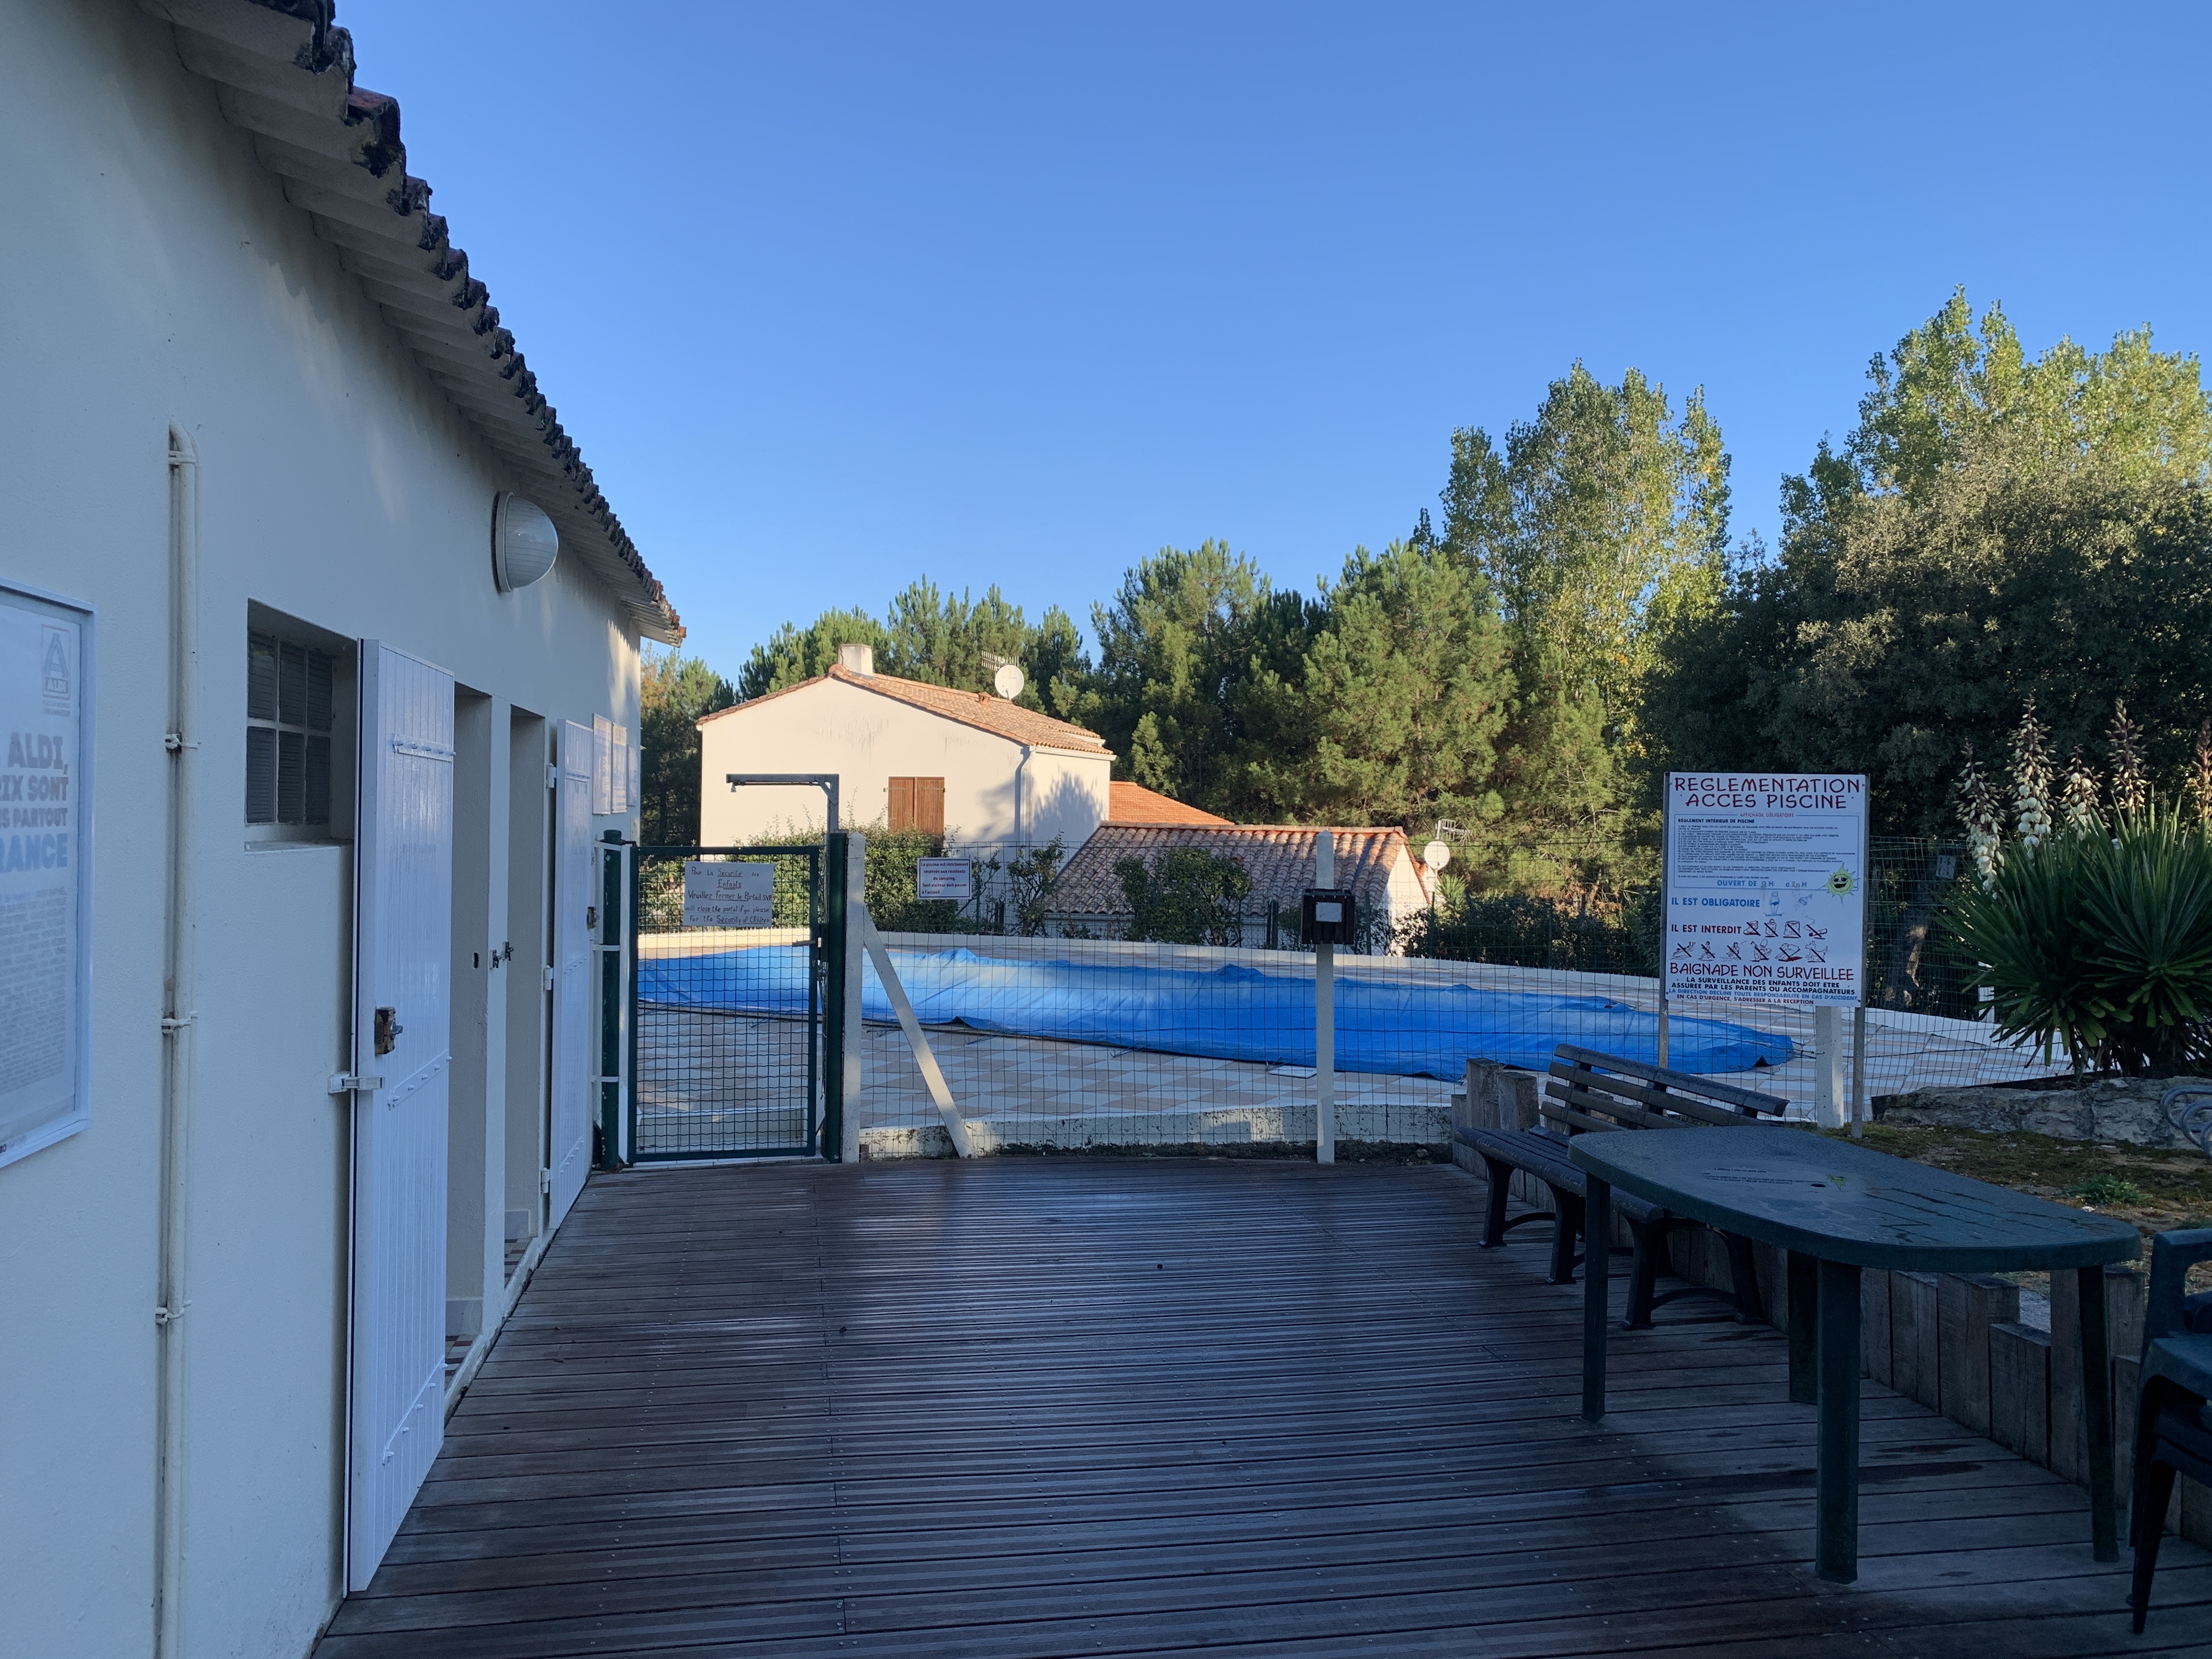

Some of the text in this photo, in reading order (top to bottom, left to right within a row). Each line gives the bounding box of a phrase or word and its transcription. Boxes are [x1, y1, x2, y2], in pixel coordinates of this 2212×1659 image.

[7, 732, 69, 775] ALDI,
[0, 775, 69, 801] IX SONT
[1675, 777, 1859, 793] REGLEMENTATION
[1685, 793, 1847, 809] ACCES PISCINE
[13, 808, 67, 828] PARTOUT
[691, 866, 702, 876] Pour
[718, 879, 742, 888] Enfants
[688, 890, 713, 899] Veuillez
[715, 890, 735, 899] Fermer
[1671, 897, 1760, 907] IL EST OBLIGATOIRE
[1671, 924, 1742, 934] IL EST INTERDIT
[1670, 962, 1854, 980] BAIGNADE NON SURVEILLEE
